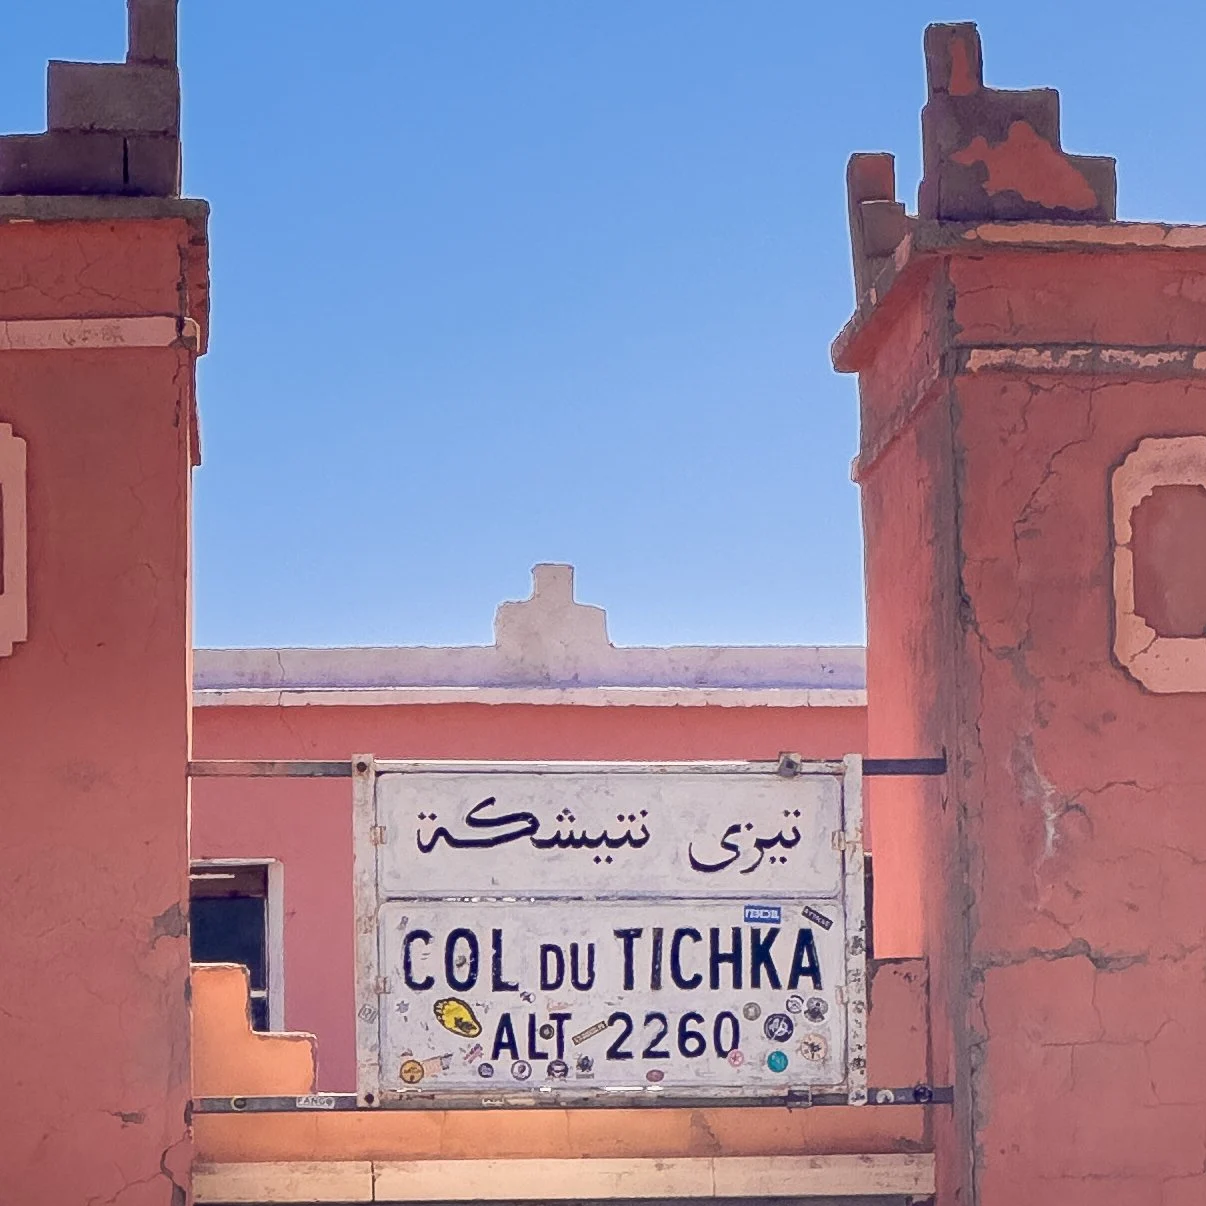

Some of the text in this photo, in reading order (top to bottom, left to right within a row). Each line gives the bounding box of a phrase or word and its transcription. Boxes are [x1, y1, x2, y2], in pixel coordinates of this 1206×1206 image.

[403, 927, 824, 992] COL DU TICHKA
[491, 1012, 571, 1060] ALT
[606, 1010, 740, 1060] 2260
